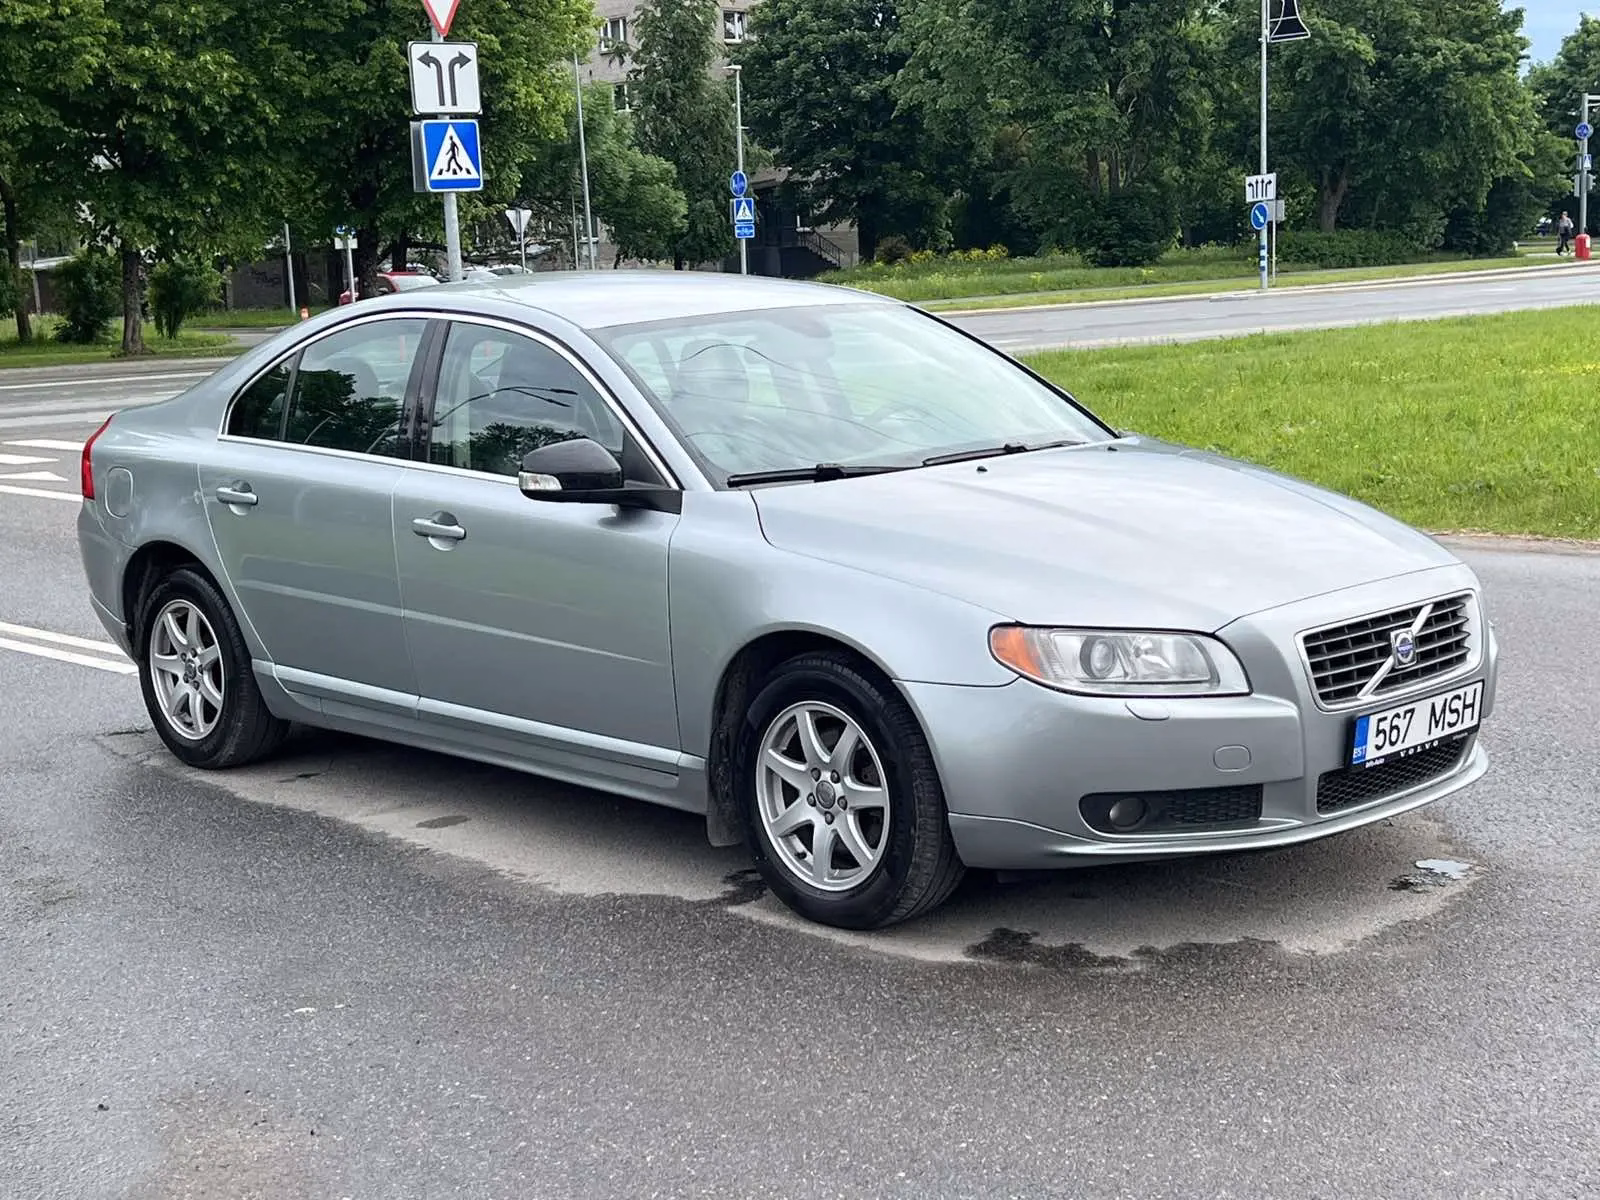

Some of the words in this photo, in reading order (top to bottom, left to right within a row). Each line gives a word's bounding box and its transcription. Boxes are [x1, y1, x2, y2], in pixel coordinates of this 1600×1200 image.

[1374, 707, 1416, 751] 567
[1428, 687, 1477, 736] MSH
[1353, 745, 1367, 759] EST
[1400, 740, 1439, 757] VOLVO
